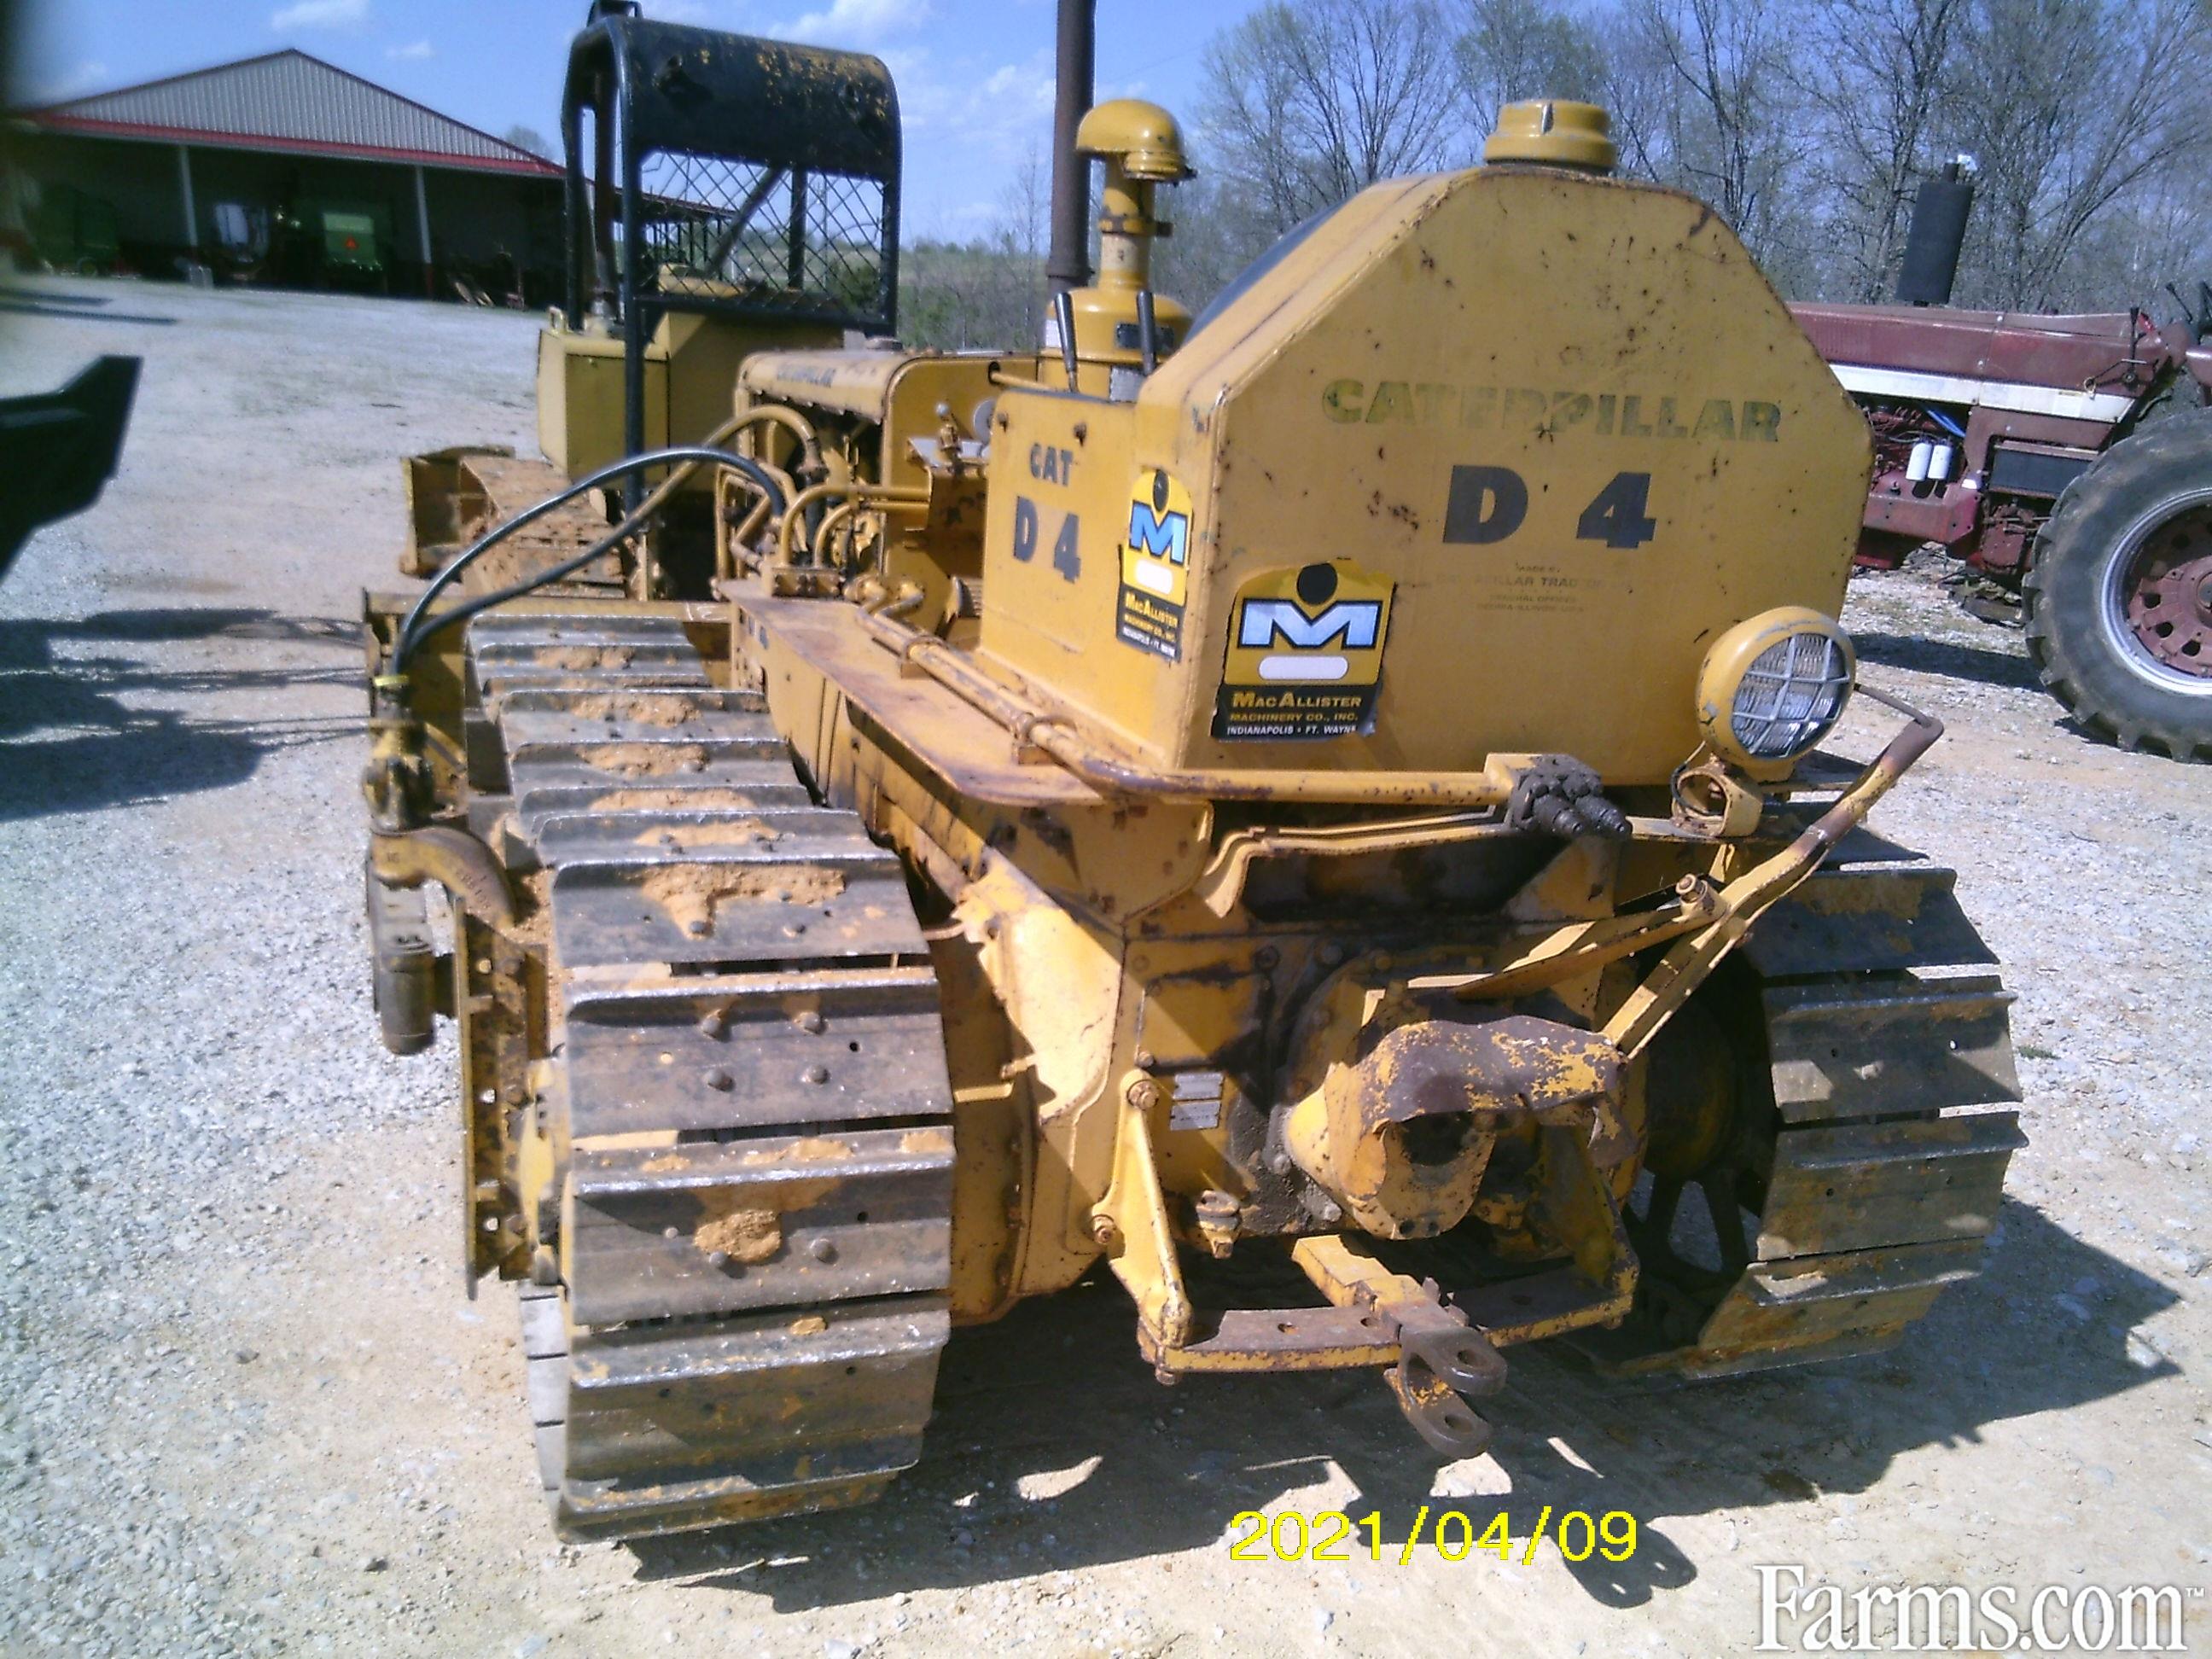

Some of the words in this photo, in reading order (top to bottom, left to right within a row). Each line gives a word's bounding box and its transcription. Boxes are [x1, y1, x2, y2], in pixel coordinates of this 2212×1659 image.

[1322, 378, 1782, 442] CATERPILLAR
[1029, 442, 1074, 486] CAT
[1443, 464, 1528, 544] D
[1575, 471, 1657, 549] 4
[1013, 495, 1039, 563] D
[1054, 513, 1081, 584] 4
[1226, 725, 1294, 735] INDIANAPOLIS
[1305, 725, 1319, 735] FT.
[1230, 712, 1302, 722] MACHINERY
[1334, 712, 1359, 722] INC.
